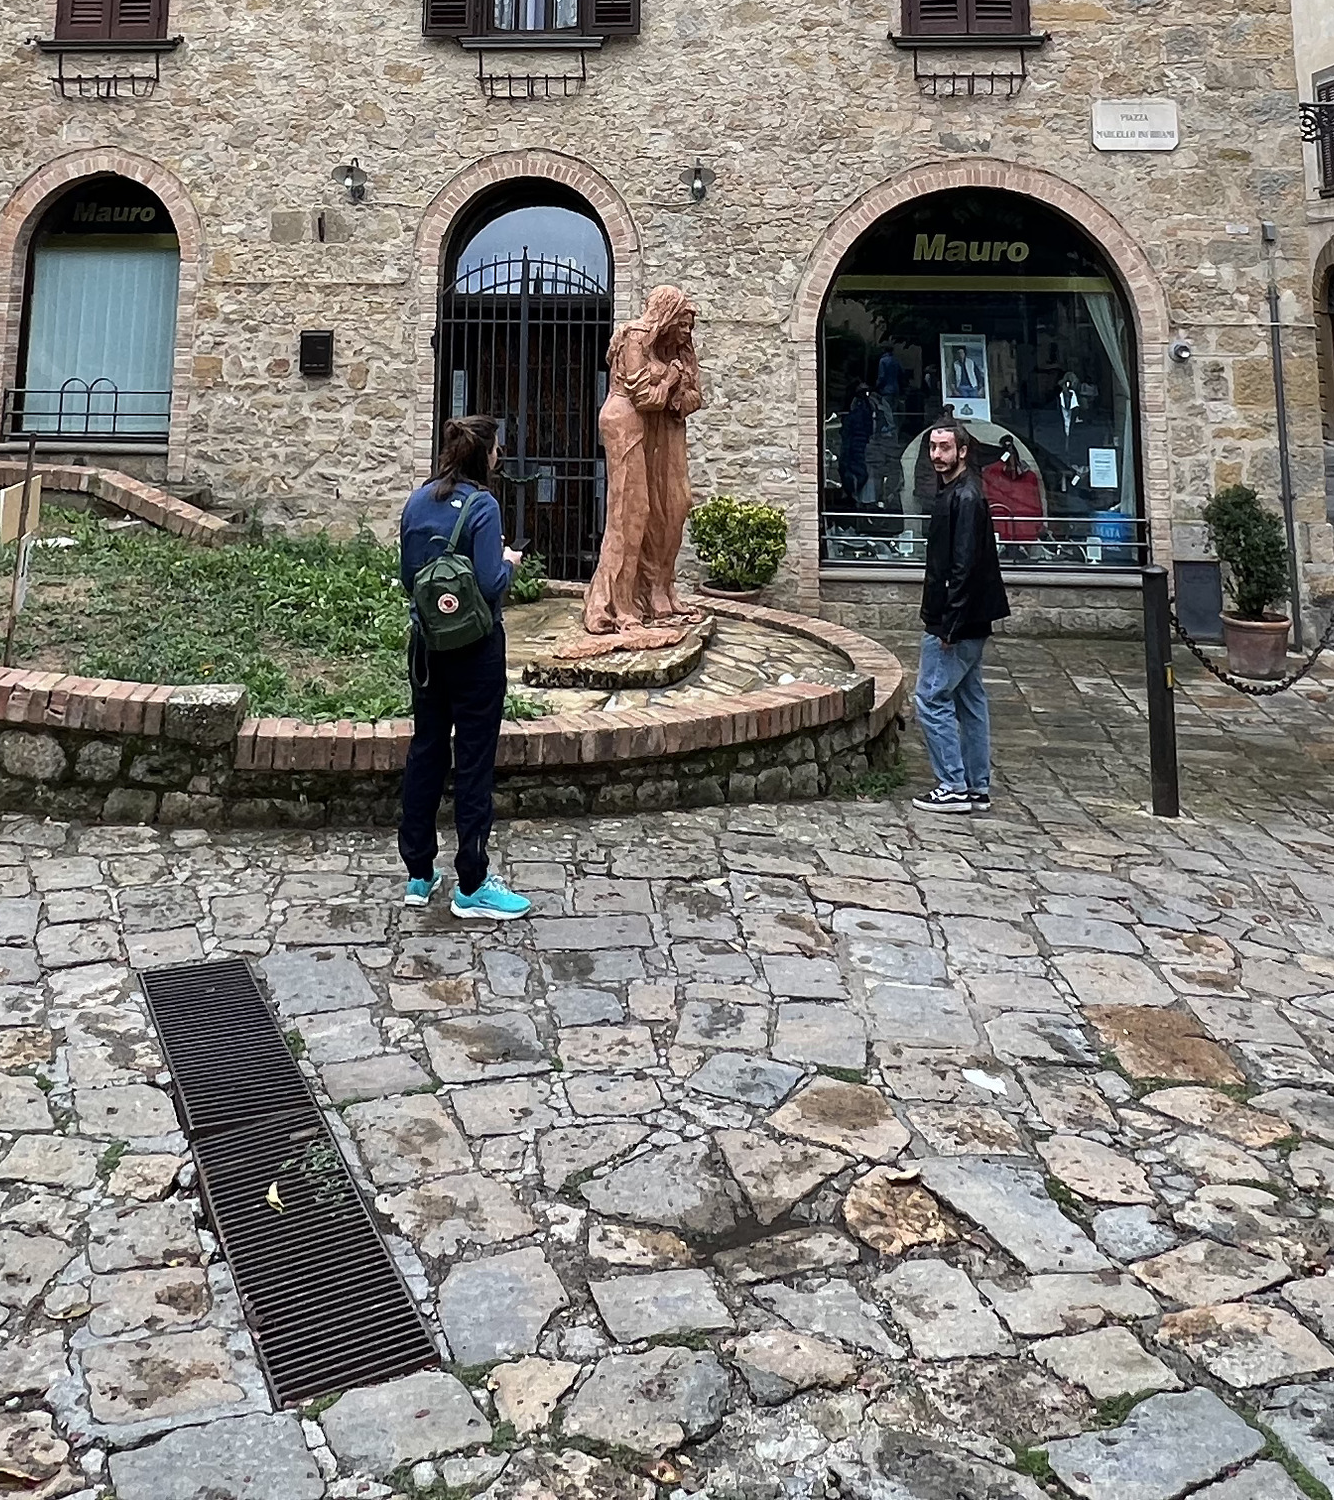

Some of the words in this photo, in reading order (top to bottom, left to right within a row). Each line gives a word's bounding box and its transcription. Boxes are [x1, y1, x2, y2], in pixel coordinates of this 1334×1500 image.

[1120, 113, 1149, 121] PIAZZA
[73, 202, 156, 222] Mauro
[913, 233, 1030, 263] Mauro
